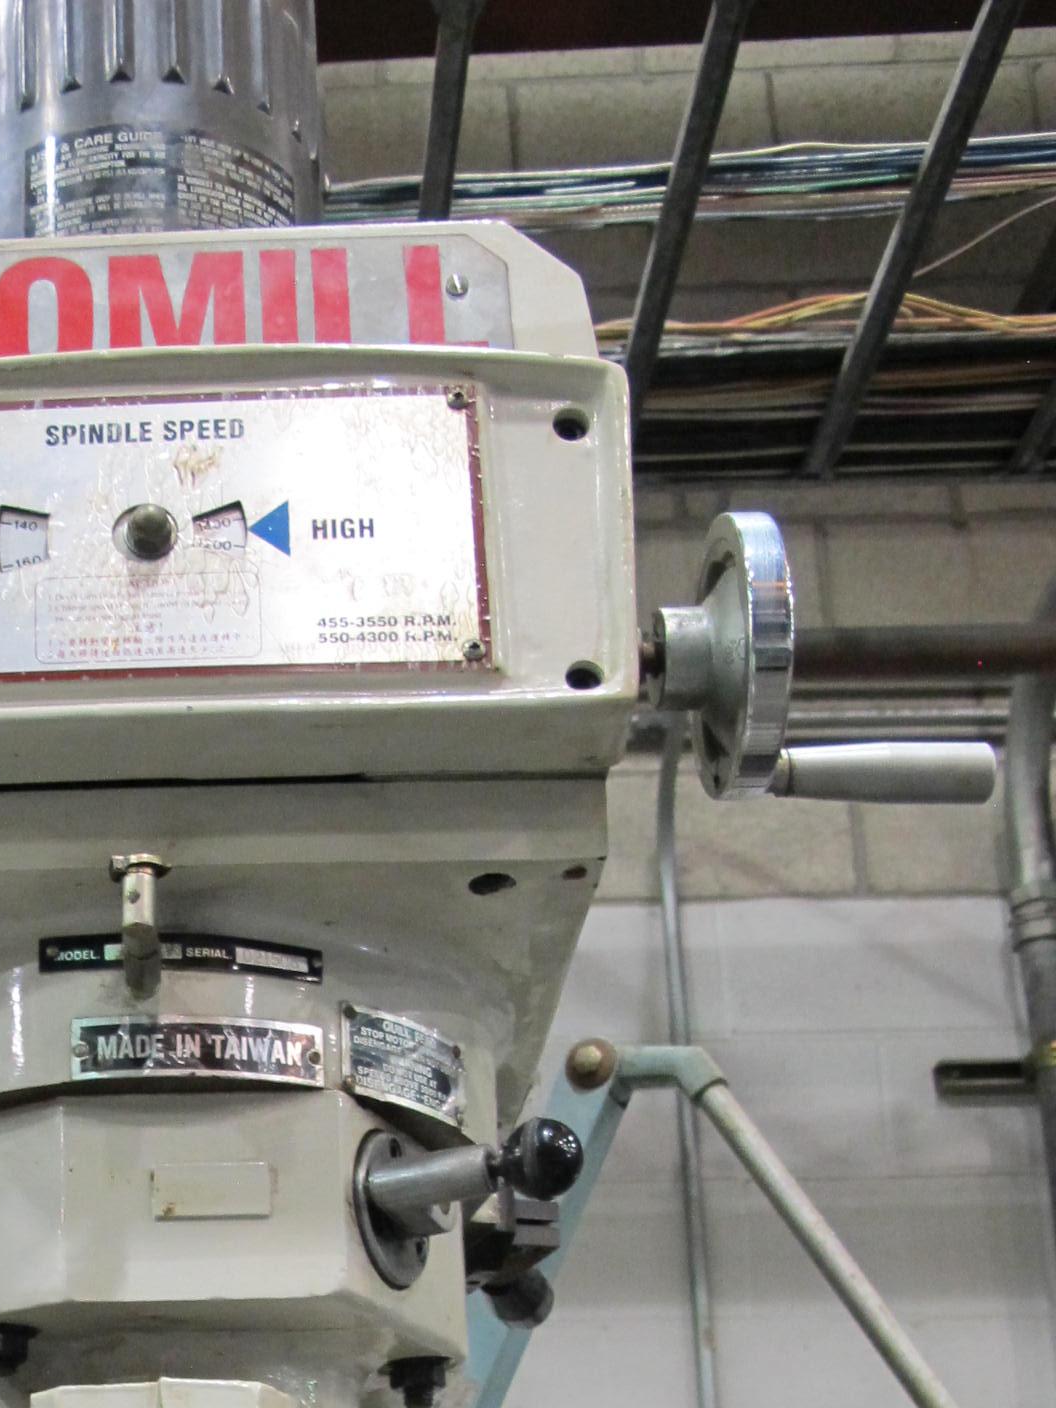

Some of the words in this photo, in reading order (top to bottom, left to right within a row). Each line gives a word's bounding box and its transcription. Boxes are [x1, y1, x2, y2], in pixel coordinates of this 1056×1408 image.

[74, 133, 114, 148] CARE
[45, 422, 152, 446] SPINDLE
[163, 418, 244, 442] SPEED
[15, 520, 38, 531] 140
[312, 518, 375, 540] HIGH
[317, 615, 398, 628] 455-3550
[318, 630, 398, 643] 550-4300
[97, 1034, 165, 1060] MADE
[175, 1033, 201, 1059] IN
[211, 1034, 303, 1065] TAIWAN
